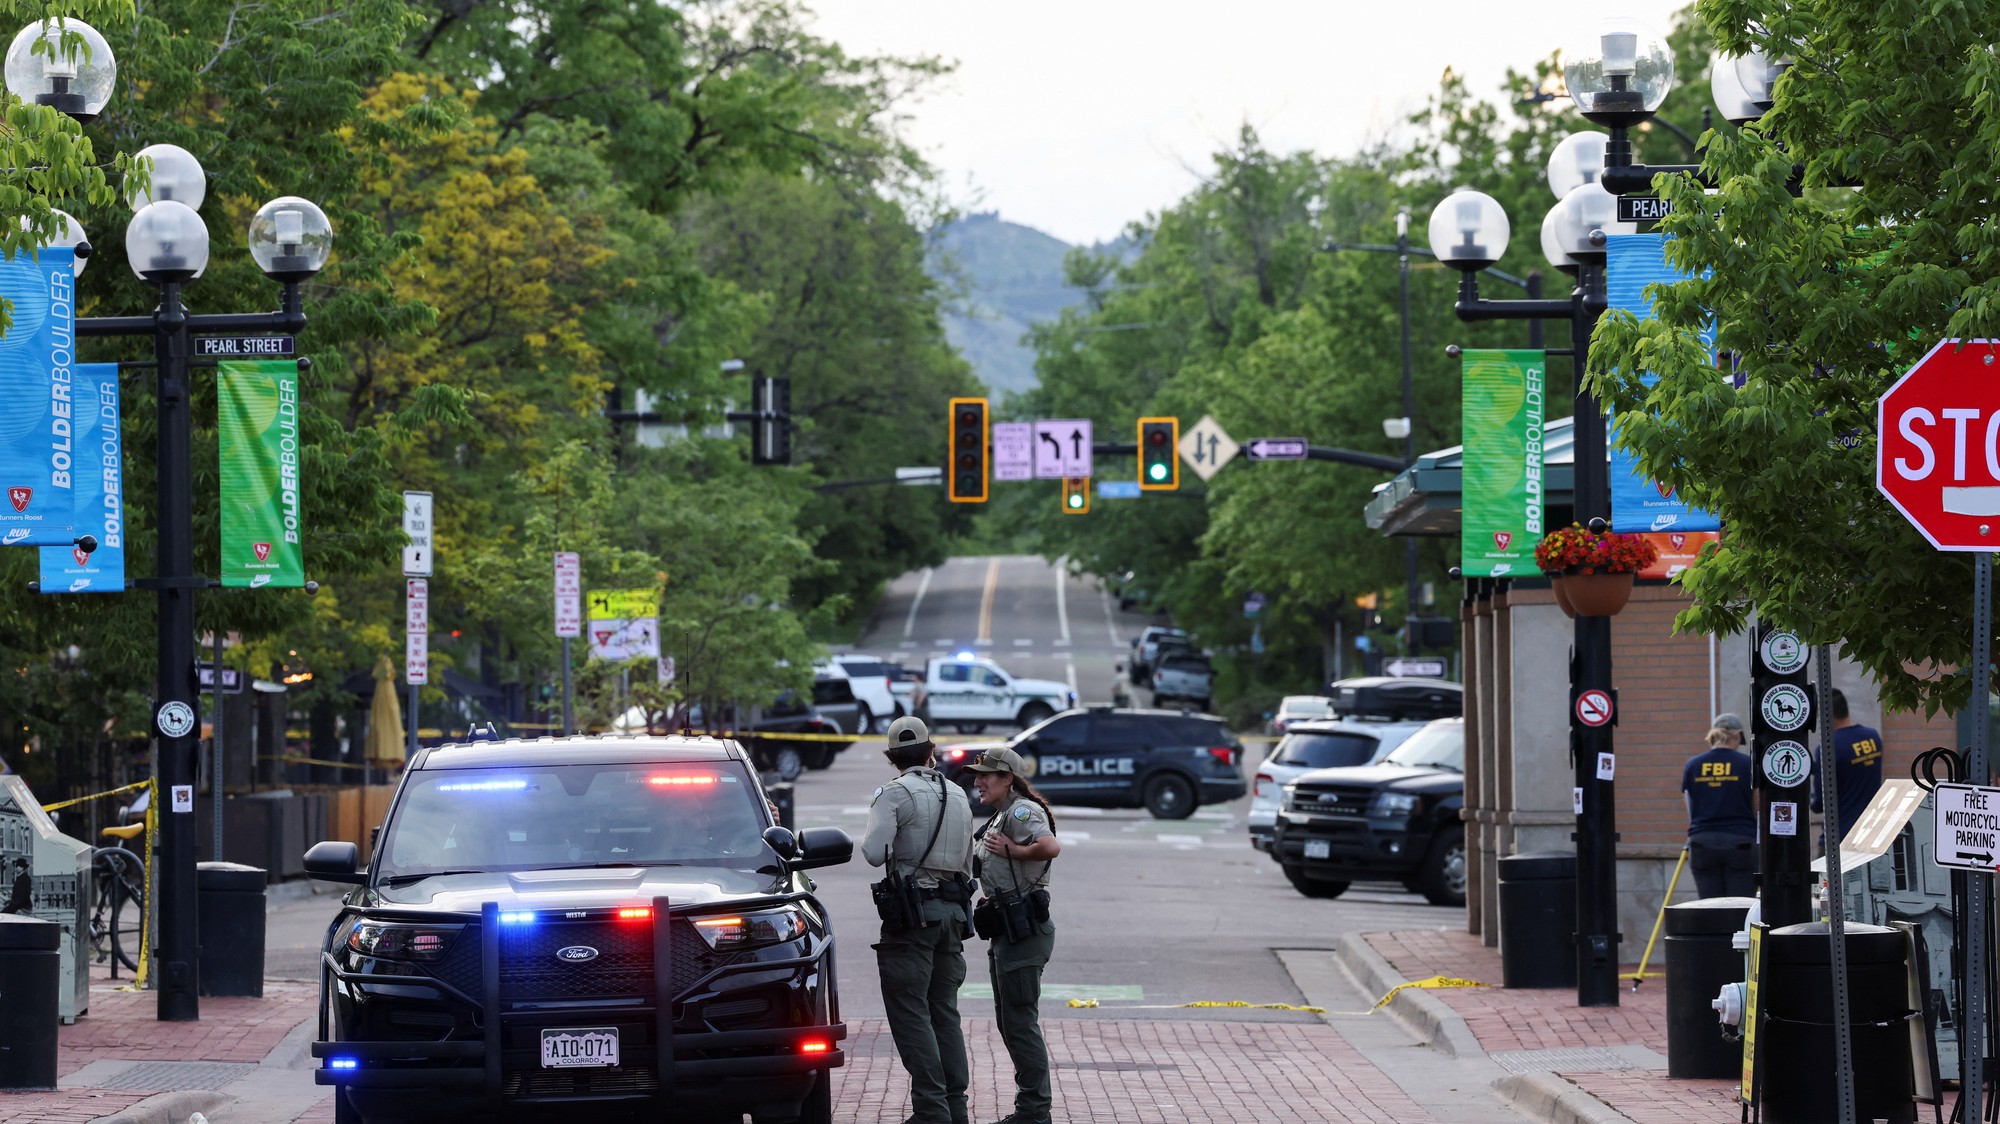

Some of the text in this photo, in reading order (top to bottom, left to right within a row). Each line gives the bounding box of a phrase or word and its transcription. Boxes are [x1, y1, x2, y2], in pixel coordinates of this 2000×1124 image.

[205, 338, 283, 354] PEARL STREET
[51, 271, 72, 489] BOLDERBOULDER
[1526, 367, 1542, 533] BOLDERBOULDER
[100, 382, 121, 548] BOLDERBOULDER
[279, 379, 299, 544] BOLDERBOULDER
[1656, 514, 1677, 524] RUN
[9, 528, 31, 538] RUN
[73, 578, 91, 587] RUN
[1764, 686, 1806, 704] SERVICE ANIMALS ONLY
[1766, 744, 1779, 756] WALK
[1790, 742, 1807, 758] WHEELS
[1852, 738, 1877, 757] FBI
[1039, 757, 1135, 776] POLICE
[1702, 762, 1731, 776] FBI
[1964, 793, 1988, 810] FREE
[1945, 810, 2000, 831] MOTORCYCL
[1956, 830, 1996, 849] PARKING
[566, 948, 589, 959] Ford
